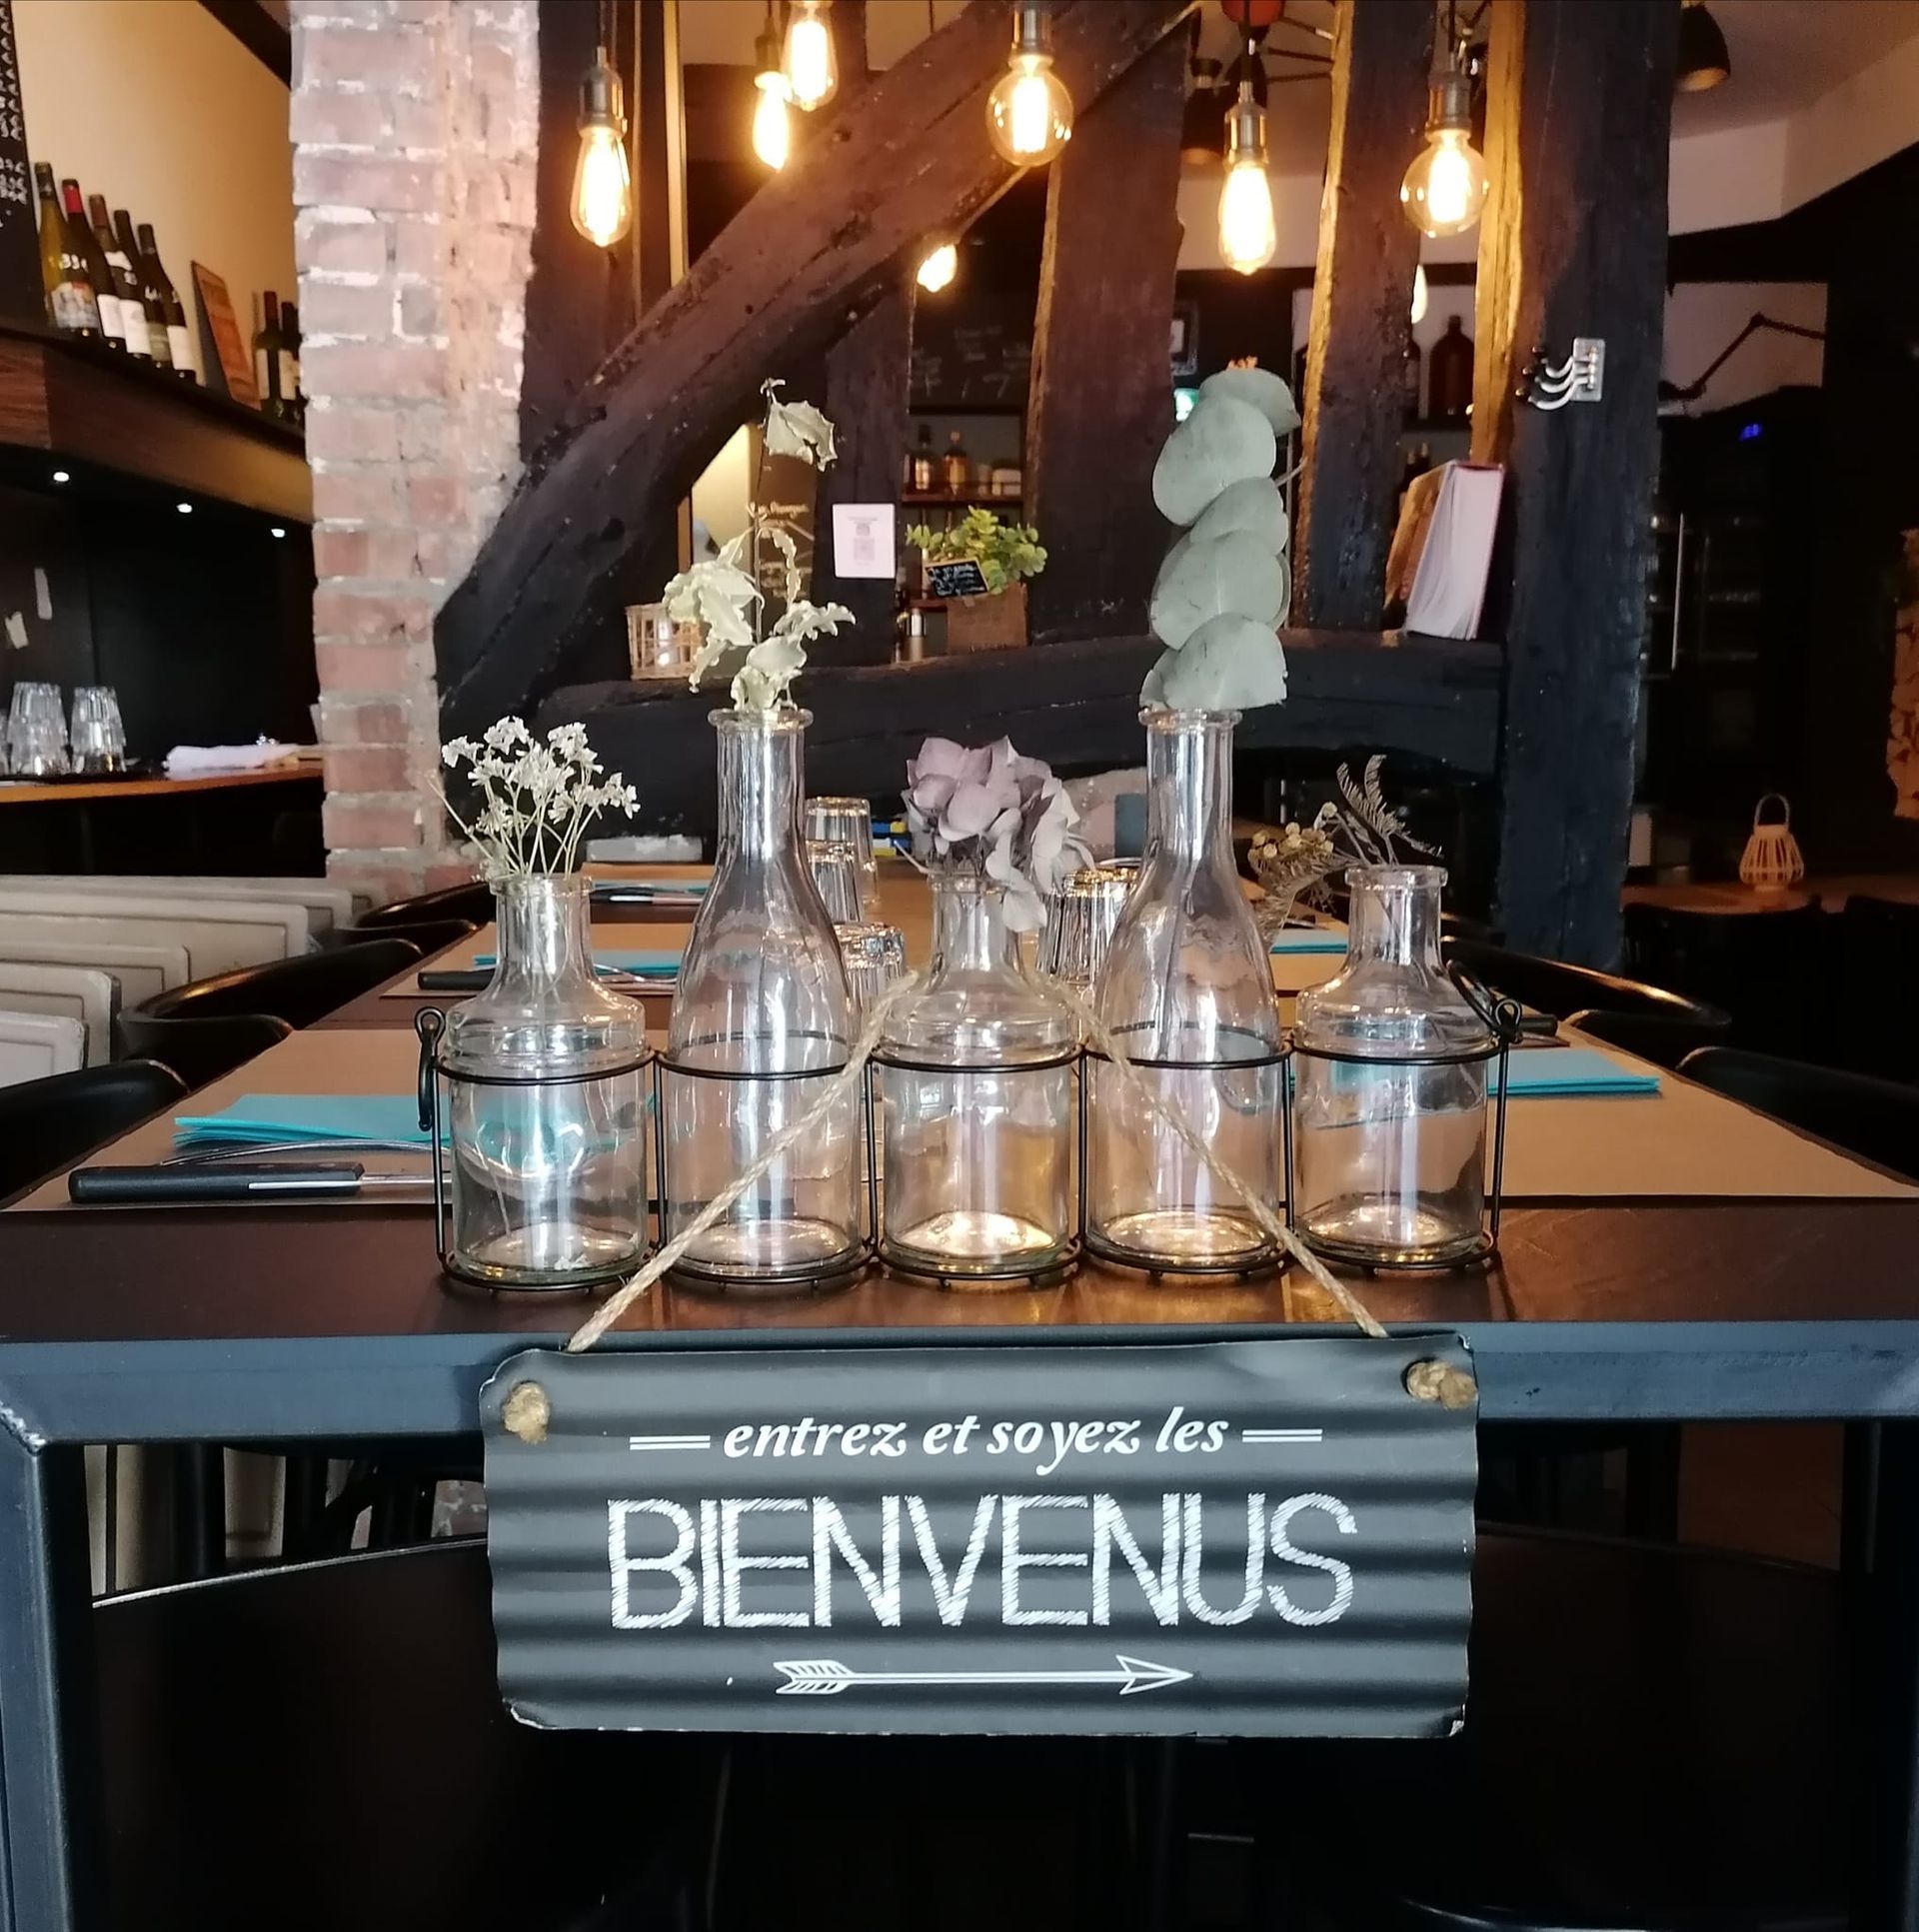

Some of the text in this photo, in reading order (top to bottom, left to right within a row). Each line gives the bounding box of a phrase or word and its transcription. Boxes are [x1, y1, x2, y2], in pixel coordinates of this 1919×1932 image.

[722, 1405, 1229, 1476] entrez et soyez les
[606, 1493, 1358, 1629] BIENVENUS
